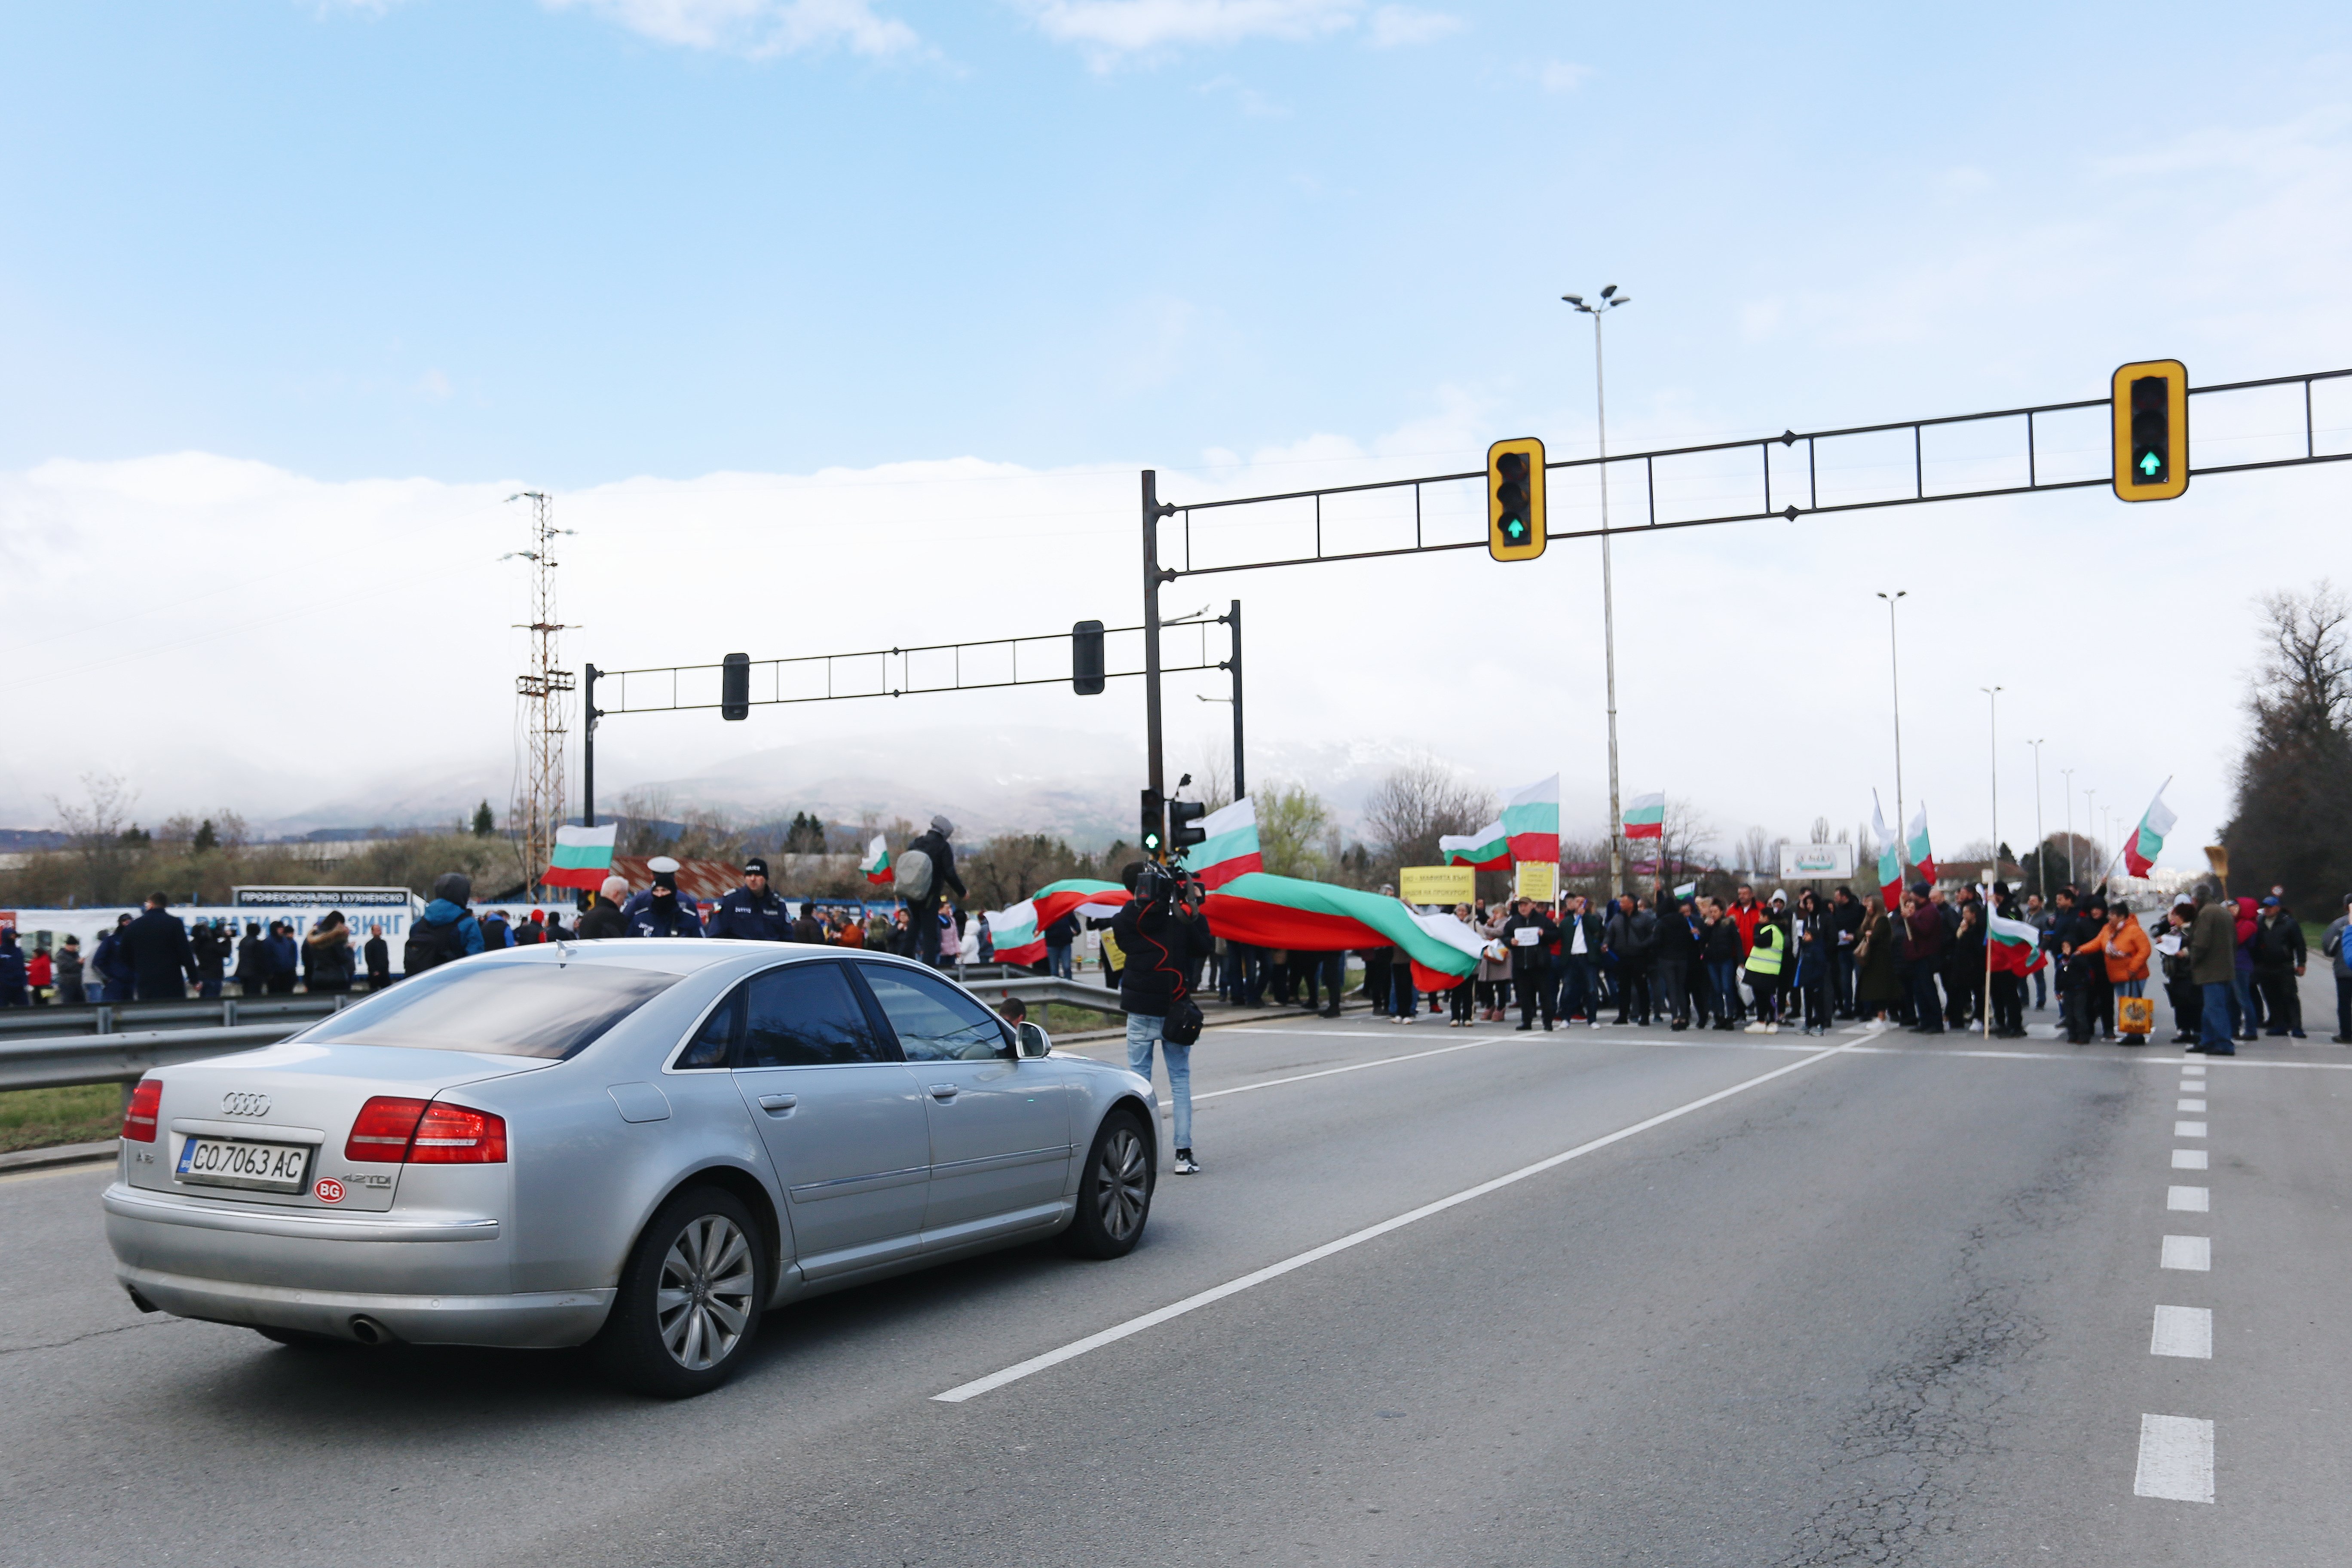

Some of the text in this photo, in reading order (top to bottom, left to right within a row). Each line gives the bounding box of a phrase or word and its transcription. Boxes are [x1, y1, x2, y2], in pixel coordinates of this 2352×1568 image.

[194, 1144, 301, 1178] CO 7063 AC
[320, 1183, 340, 1197] BG
